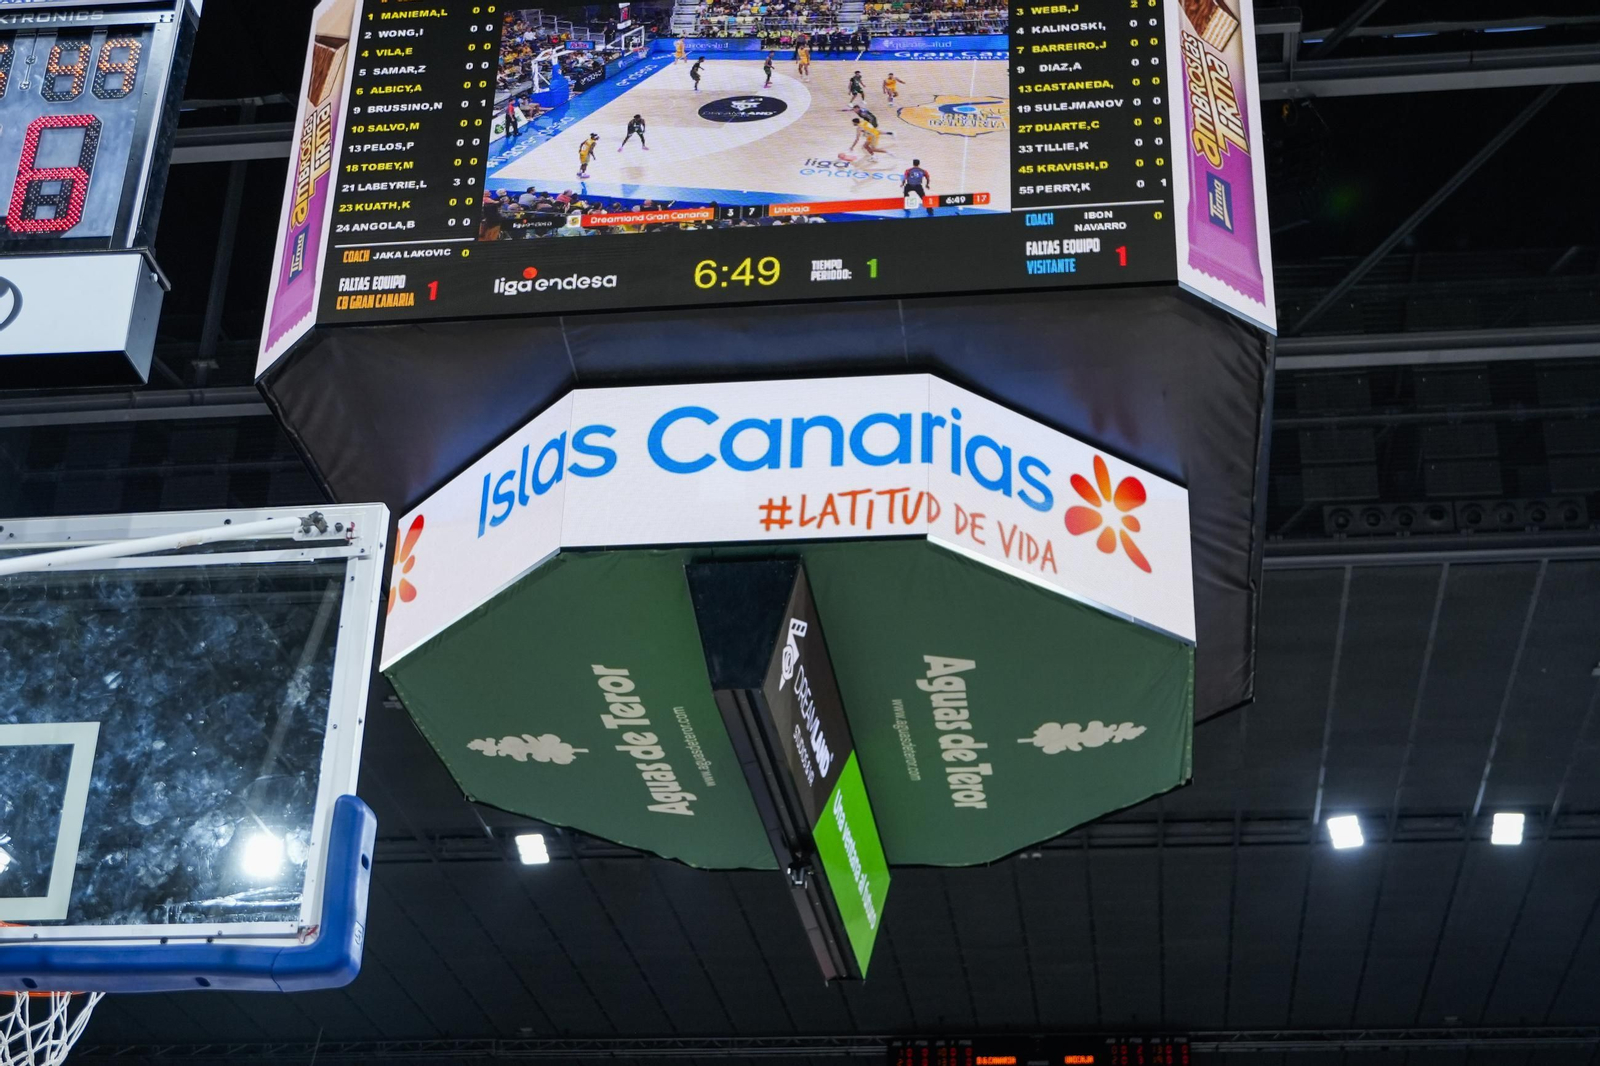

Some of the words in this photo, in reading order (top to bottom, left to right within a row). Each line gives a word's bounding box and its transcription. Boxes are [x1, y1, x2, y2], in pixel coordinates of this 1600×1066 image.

[381, 9, 448, 20] MANIEMA,L
[1016, 8, 1024, 16] 3
[1031, 4, 1079, 15] WEBB,J
[1130, 0, 1138, 8] 2
[364, 31, 372, 39] 2
[378, 28, 424, 38] WONG,I
[1016, 27, 1024, 35] 4
[1031, 22, 1106, 34] KALINOSKI,
[1129, 19, 1138, 27] 0
[1149, 18, 1157, 26] 0
[376, 47, 413, 57] VILA,E
[1016, 46, 1024, 54] 7
[1032, 41, 1107, 53] BARREIRO,J
[1130, 39, 1139, 47] 0
[373, 65, 426, 75] SAMAR,Z
[465, 62, 473, 70] 0
[481, 61, 489, 69] 0
[1016, 66, 1025, 74] 9
[1039, 62, 1082, 72] DIAZ,A
[1131, 58, 1140, 66] 0
[1151, 57, 1159, 65] 0
[370, 84, 422, 94] ALBICY,A
[463, 81, 471, 89] 0
[479, 80, 487, 88] 0
[1018, 85, 1032, 93] 13
[1034, 80, 1114, 92] CASTANEDA,
[1132, 78, 1140, 86] 0
[1152, 77, 1160, 85] 0
[367, 102, 443, 113] BRUSSINO,N
[461, 100, 469, 108] 0
[480, 99, 486, 107] 1
[1017, 105, 1031, 113] 19
[1034, 99, 1124, 112] SULEJMANOV
[1133, 98, 1141, 106] 0
[1153, 97, 1161, 105] 0
[351, 125, 365, 133] 10
[367, 122, 420, 132] SALVO,M
[460, 119, 468, 127] 0
[1018, 124, 1033, 133] 27
[1035, 120, 1100, 132] DUARTE,C
[1134, 118, 1142, 126] 0
[1154, 117, 1162, 125] 0
[348, 145, 362, 153] 13
[363, 142, 414, 152] PELOS,P
[456, 139, 464, 147] 0
[472, 138, 480, 146] 0
[1018, 145, 1033, 154] 33
[1035, 141, 1089, 152] TILLIE,K
[1134, 138, 1143, 147] 0
[1154, 137, 1163, 145] 0
[6, 114, 97, 232] 6
[345, 164, 359, 172] 18
[360, 161, 414, 171] TOBEY,M
[454, 158, 462, 166] 0
[1018, 165, 1034, 174] 45
[1037, 161, 1109, 173] KRAVISH,D
[1135, 159, 1144, 167] 0
[1155, 158, 1164, 166] 0
[341, 184, 355, 192] 21
[357, 180, 427, 191] LABEYRIE,L
[453, 178, 461, 186] 3
[467, 177, 475, 185] 0
[1019, 186, 1034, 195] 55
[1036, 182, 1091, 194] PERRY,K
[1136, 179, 1145, 188] 0
[1160, 178, 1167, 187] 1
[339, 204, 353, 212] 23
[355, 200, 411, 211] KUATH,K
[449, 198, 457, 206] 0
[465, 197, 473, 205] 0
[1209, 179, 1225, 221] Tirma
[590, 213, 644, 224] Dreamland
[645, 211, 670, 221] Gran
[671, 210, 709, 220] Canaria
[749, 207, 756, 216] 7
[773, 205, 811, 215] Unicaja
[945, 196, 966, 205] 6:49
[975, 195, 988, 204] 17
[1084, 210, 1113, 220] IBON
[335, 224, 350, 233] 24
[351, 220, 415, 232] ANGOLA,B
[448, 218, 456, 226] 0
[462, 218, 471, 226] 0
[1025, 212, 1054, 227] COACH
[1154, 211, 1162, 220] 0
[1074, 221, 1127, 232] NAVARRO
[290, 233, 305, 278] Tirma
[343, 249, 370, 263] COACH
[372, 251, 402, 260] JAKA
[403, 248, 451, 258] LAKOVIC
[461, 249, 470, 257] 0
[1026, 239, 1060, 256] FALTAS
[1062, 237, 1101, 255] EQUIPO
[1115, 245, 1127, 266] 1
[694, 257, 781, 289] 6:49
[811, 259, 843, 271] TIEMPO
[866, 258, 878, 278] 1
[1026, 258, 1076, 275] VISITANTE
[338, 276, 371, 292] FALTAS
[372, 274, 406, 291] EQUIPO
[427, 280, 439, 301] 1
[336, 295, 349, 310] CB
[349, 294, 375, 309] GRAN
[375, 292, 415, 308] CANARIA
[478, 425, 618, 538] Islas
[647, 405, 1054, 512] Canarias
[758, 487, 941, 531] #LATITUD
[954, 503, 986, 545] DE
[997, 520, 1057, 574] VIDA
[591, 664, 651, 729] Teror
[916, 655, 976, 731] Aguas
[794, 665, 831, 778] DREAMLAND
[615, 731, 665, 760] de
[938, 733, 988, 762] de
[636, 762, 697, 816] Aguas
[945, 763, 993, 809] Teror
[833, 788, 846, 832] Una
